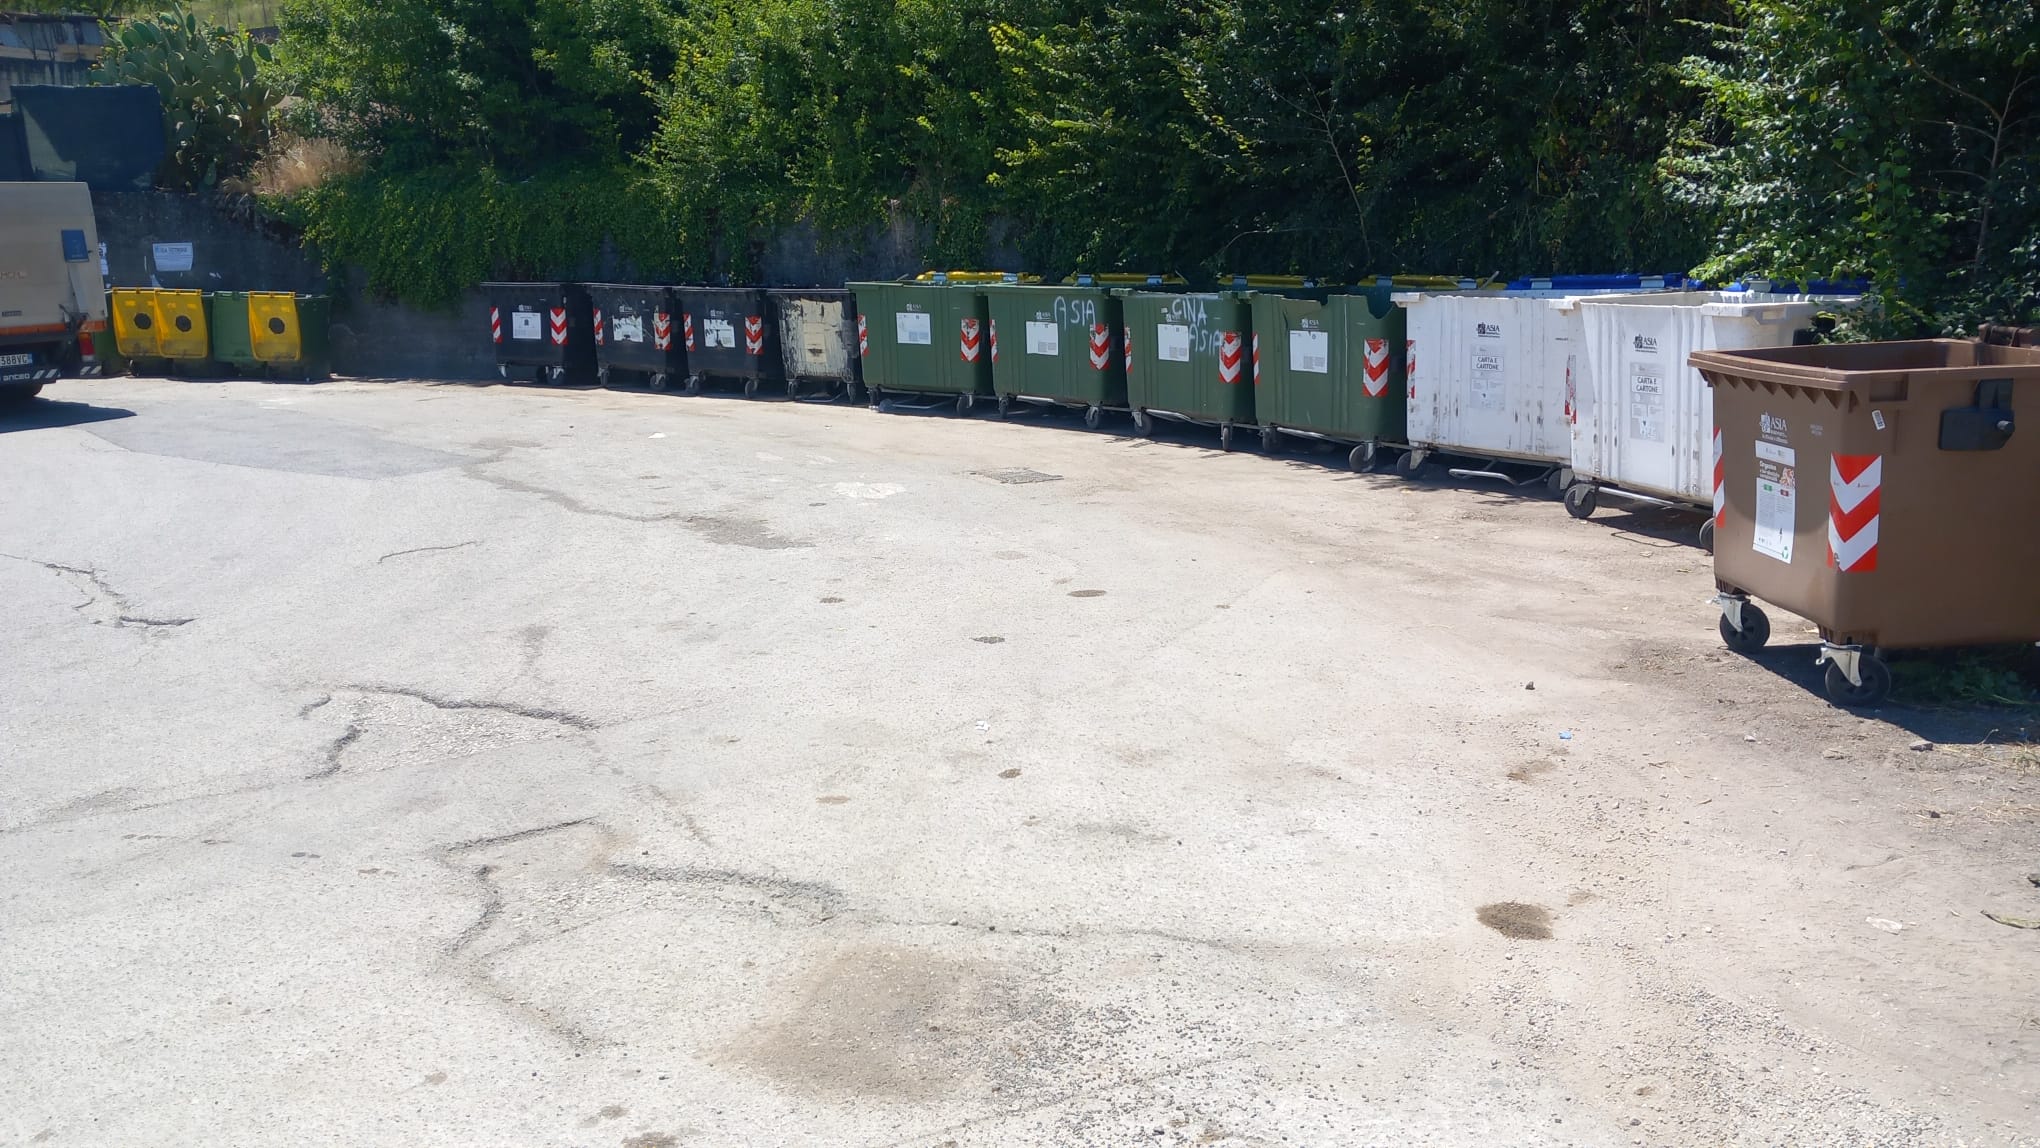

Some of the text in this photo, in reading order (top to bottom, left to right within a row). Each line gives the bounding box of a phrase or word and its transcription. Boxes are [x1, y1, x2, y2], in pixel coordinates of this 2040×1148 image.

[1053, 295, 1096, 331] ASIA
[1172, 296, 1208, 326] CINA
[1486, 324, 1500, 332] ASIA
[1188, 323, 1223, 356] ASIA
[1643, 337, 1657, 346] ASIA
[1637, 376, 1653, 385] CARTA
[1635, 384, 1658, 393] CARTONE
[1771, 416, 1787, 431] ASIA
